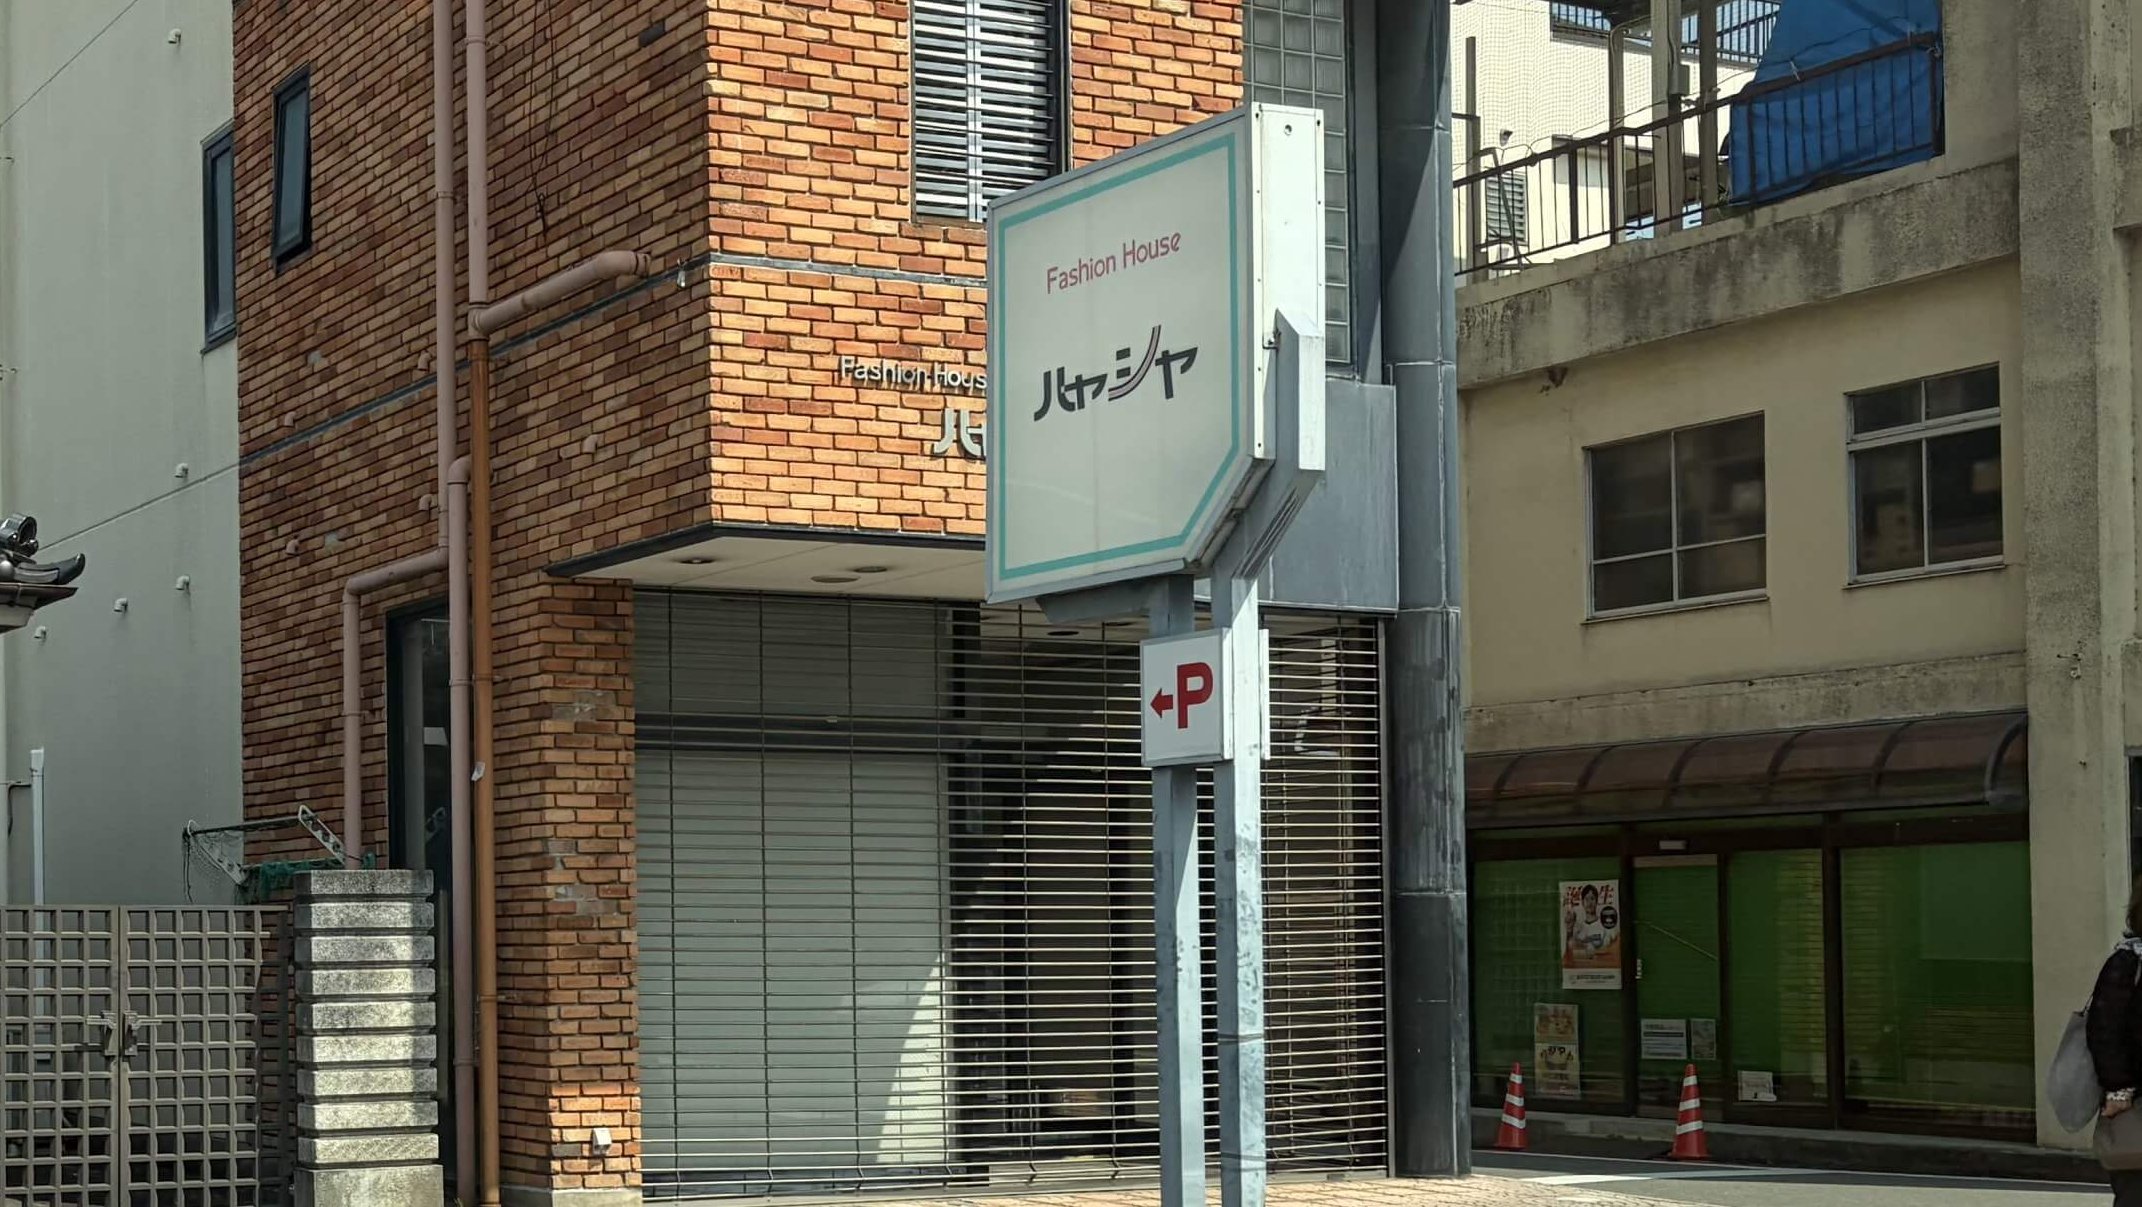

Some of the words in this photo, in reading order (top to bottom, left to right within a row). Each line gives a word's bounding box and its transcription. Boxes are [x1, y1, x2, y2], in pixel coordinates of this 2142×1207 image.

[1046, 257, 1116, 294] Fashion
[1122, 232, 1181, 269] House
[841, 355, 928, 386] Fashion
[933, 361, 987, 389] Hous
[1176, 661, 1214, 729] P
